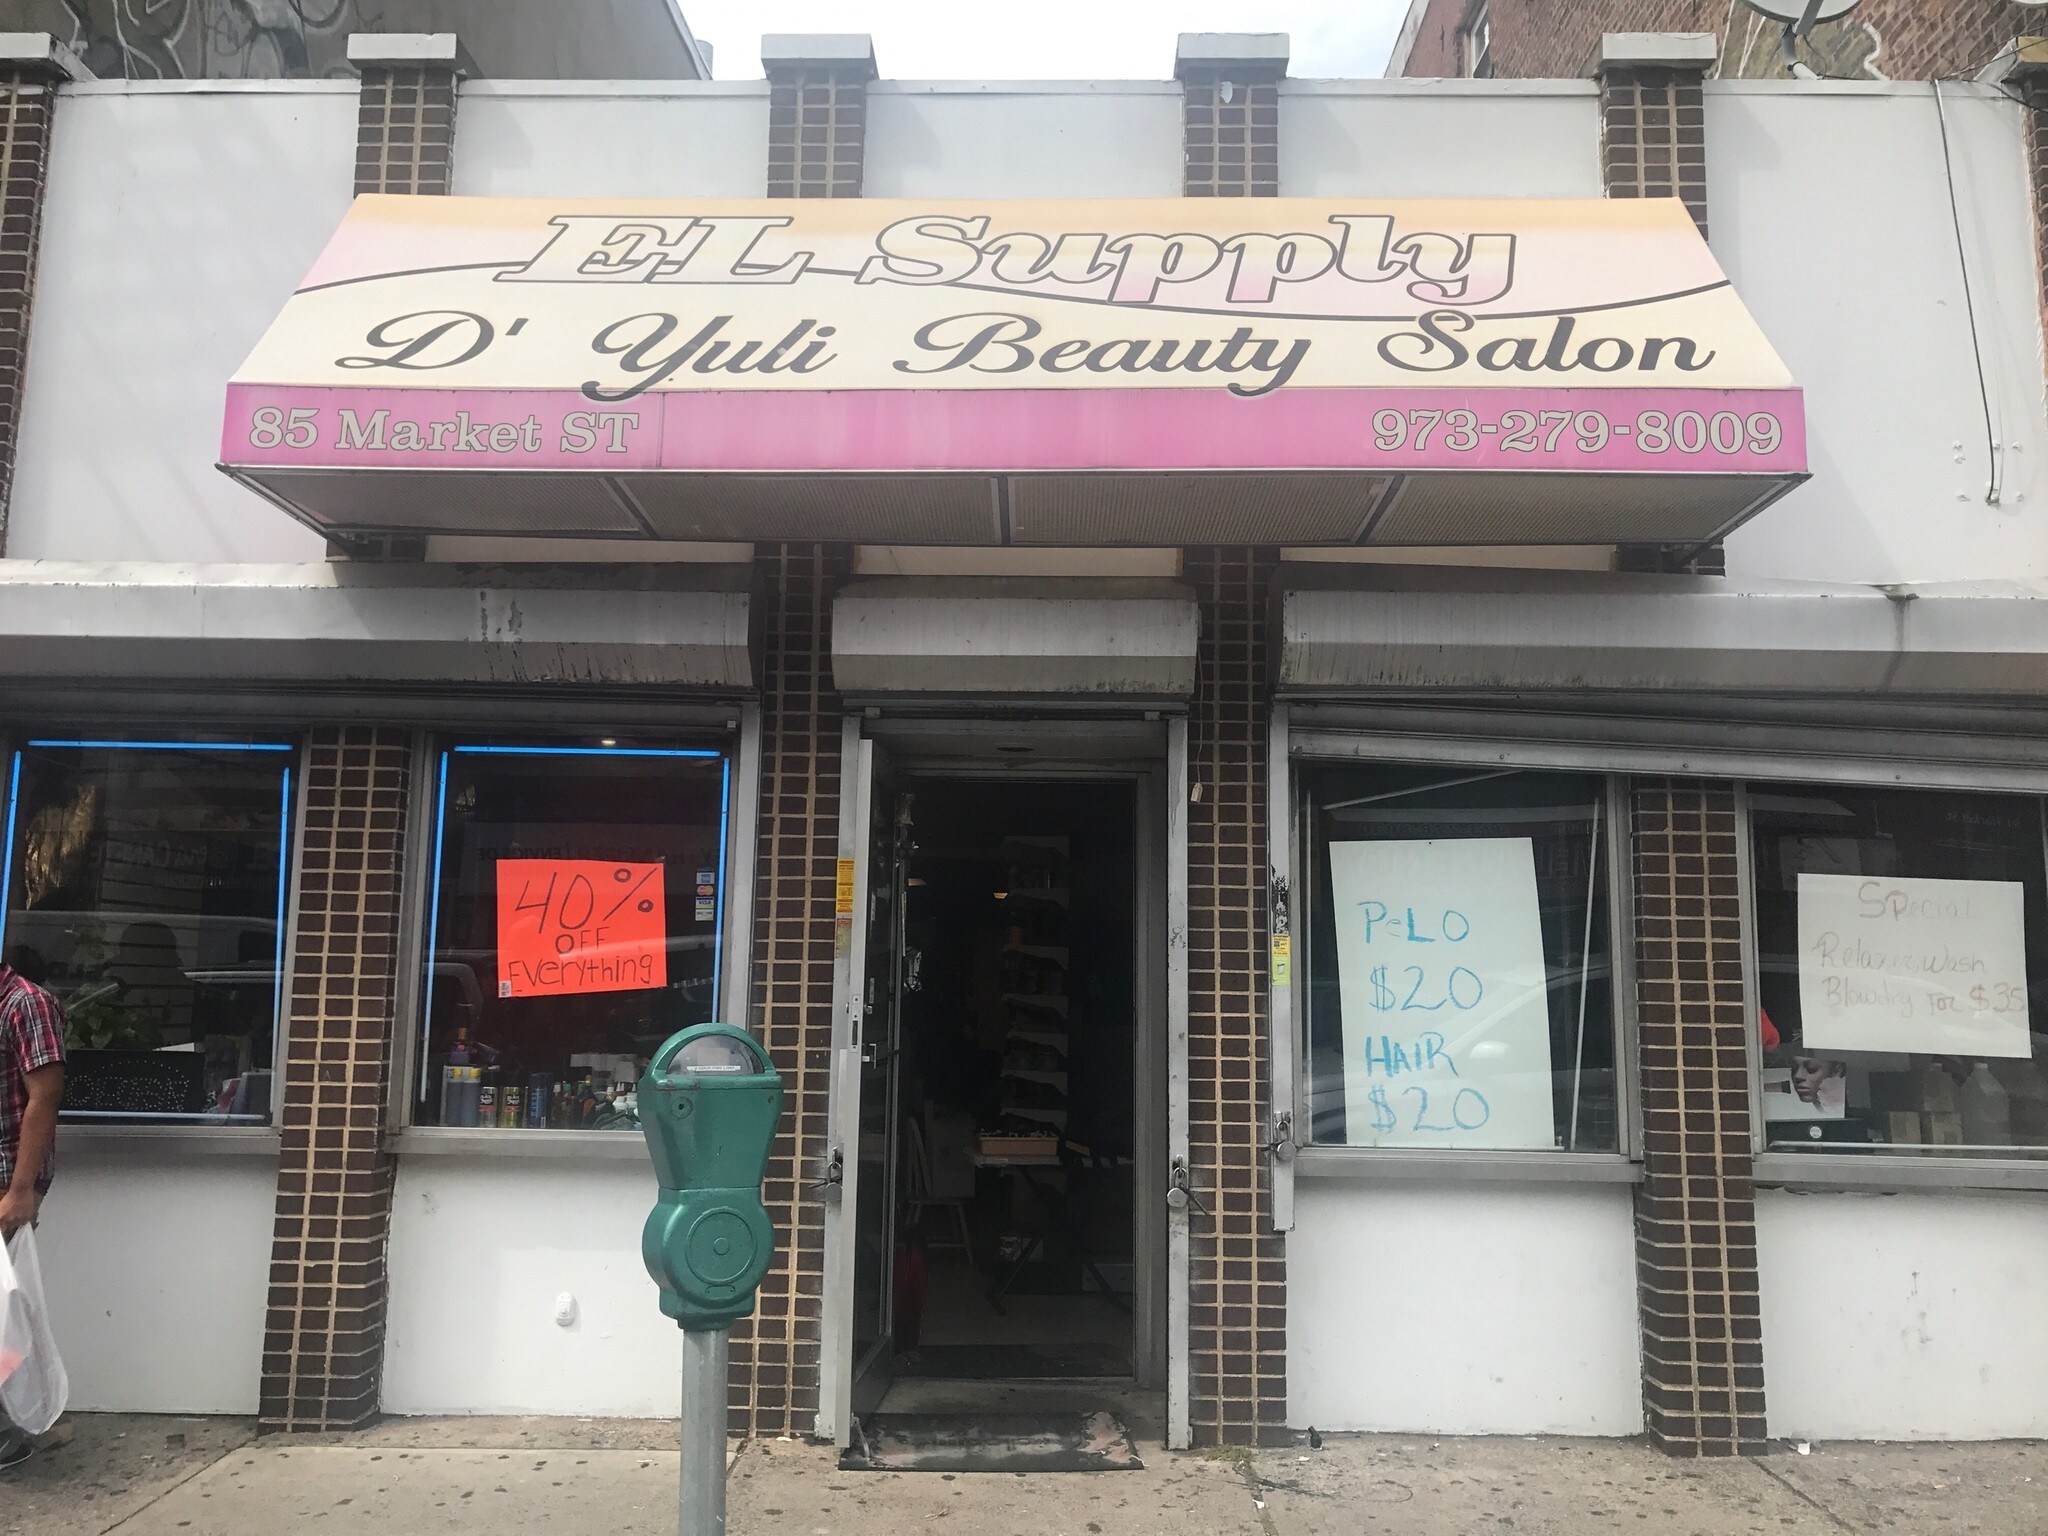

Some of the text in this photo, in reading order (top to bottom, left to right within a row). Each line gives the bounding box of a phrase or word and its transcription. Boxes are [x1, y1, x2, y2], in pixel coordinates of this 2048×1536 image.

[855, 214, 1515, 305] Supply
[334, 310, 1715, 402] D' Yuli Beauty Salon
[249, 408, 641, 454] 85 Market ST
[1371, 408, 1783, 455] 973-279-8009
[515, 867, 658, 934] 40%
[555, 928, 609, 954] OFF
[1370, 964, 1483, 1013] $20
[1365, 1031, 1459, 1078] HAIR
[1368, 1086, 1489, 1134] $20
